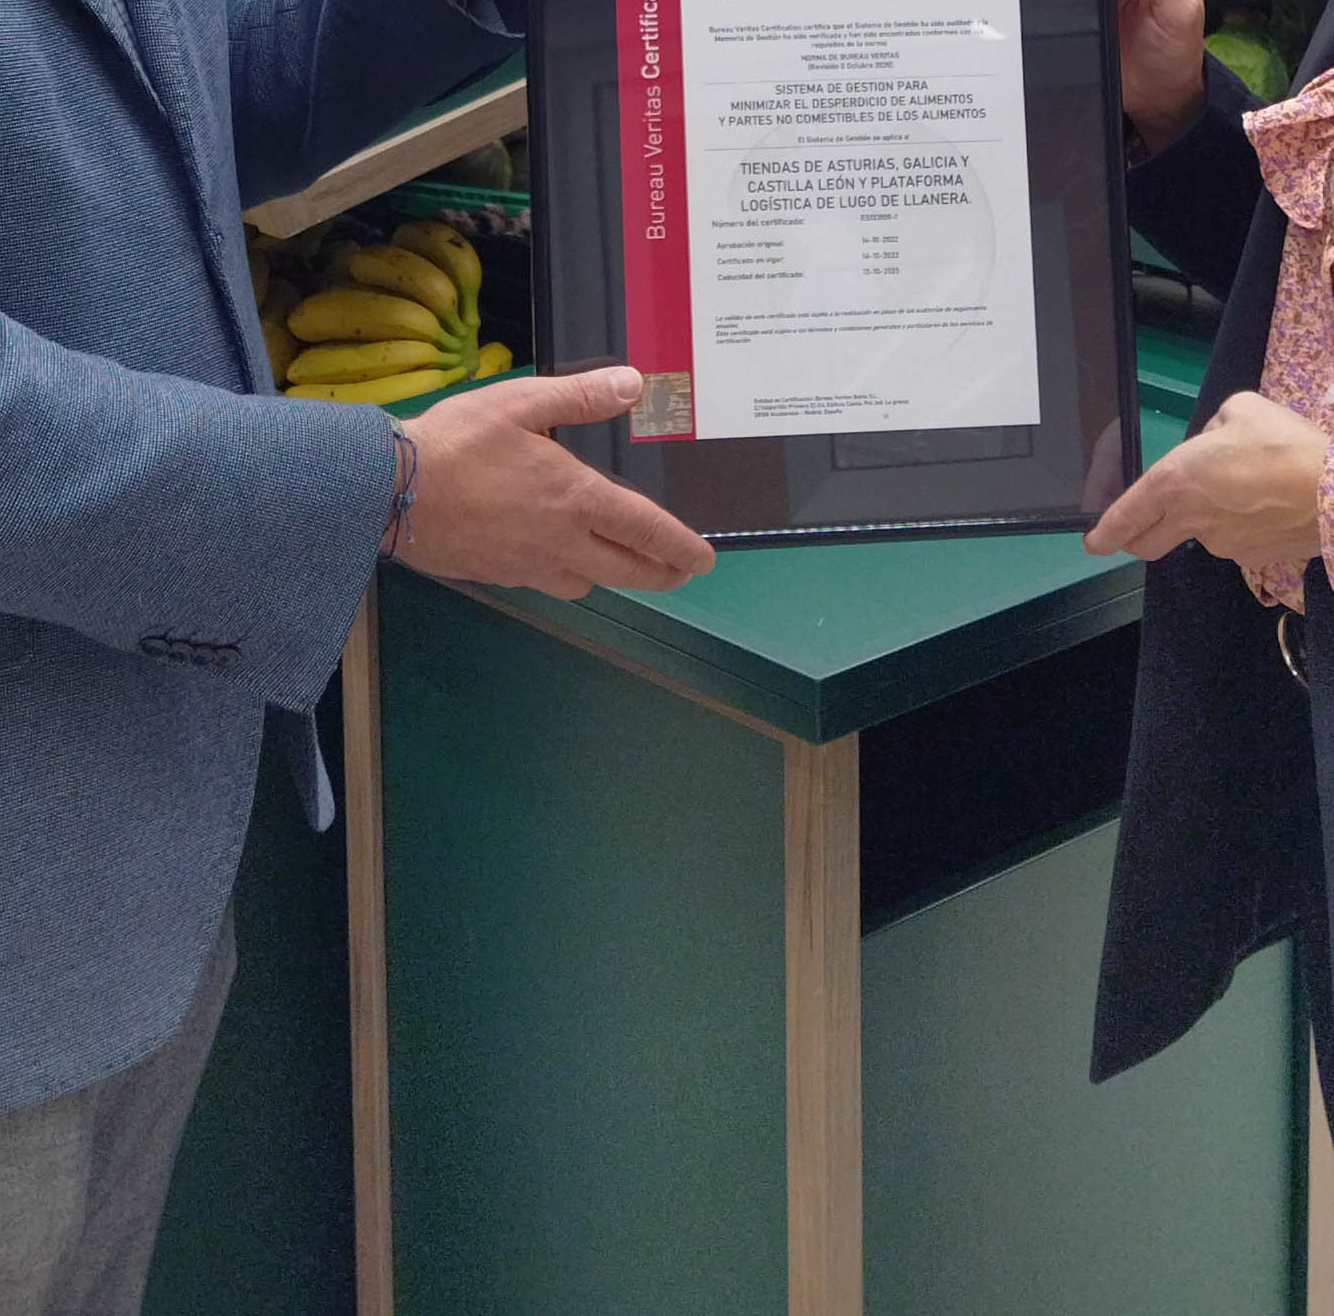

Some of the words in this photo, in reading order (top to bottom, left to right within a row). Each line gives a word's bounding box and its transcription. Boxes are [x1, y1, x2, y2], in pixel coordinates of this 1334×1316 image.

[775, 84, 824, 95] SISTEMA
[827, 83, 842, 94] DE
[845, 81, 894, 93] GESTION
[897, 80, 928, 92] PARA
[731, 98, 791, 111] MINIMIZAR
[795, 98, 809, 110] EL
[812, 96, 888, 109] DESPERDICIO
[890, 95, 906, 106] DE
[909, 93, 974, 106] ALIMENTOS
[642, 85, 662, 158] Veritas
[718, 116, 726, 127] Y
[728, 114, 773, 126] PARTES
[776, 113, 793, 125] NO
[796, 111, 875, 124] COMESTIBLES
[877, 110, 893, 122] DE
[896, 109, 919, 121] LOS
[921, 108, 987, 120] ALIMENTOS
[739, 161, 800, 175] TIENDAS
[804, 160, 823, 173] DE
[827, 158, 900, 173] ASTURIAS,
[903, 156, 957, 170] GALICIA
[960, 155, 969, 168] Y
[747, 180, 814, 193] CASTILLA
[818, 175, 855, 191] LEÓN
[858, 177, 868, 189] Y
[871, 174, 964, 189] PLATAFORMA
[646, 163, 666, 239] Bureau
[740, 196, 812, 212] LOGÍSTICA
[816, 197, 835, 209] DE
[839, 195, 877, 208] LUGO
[881, 194, 899, 207] DE
[903, 192, 972, 206] LLANERA.
[746, 219, 759, 227] del
